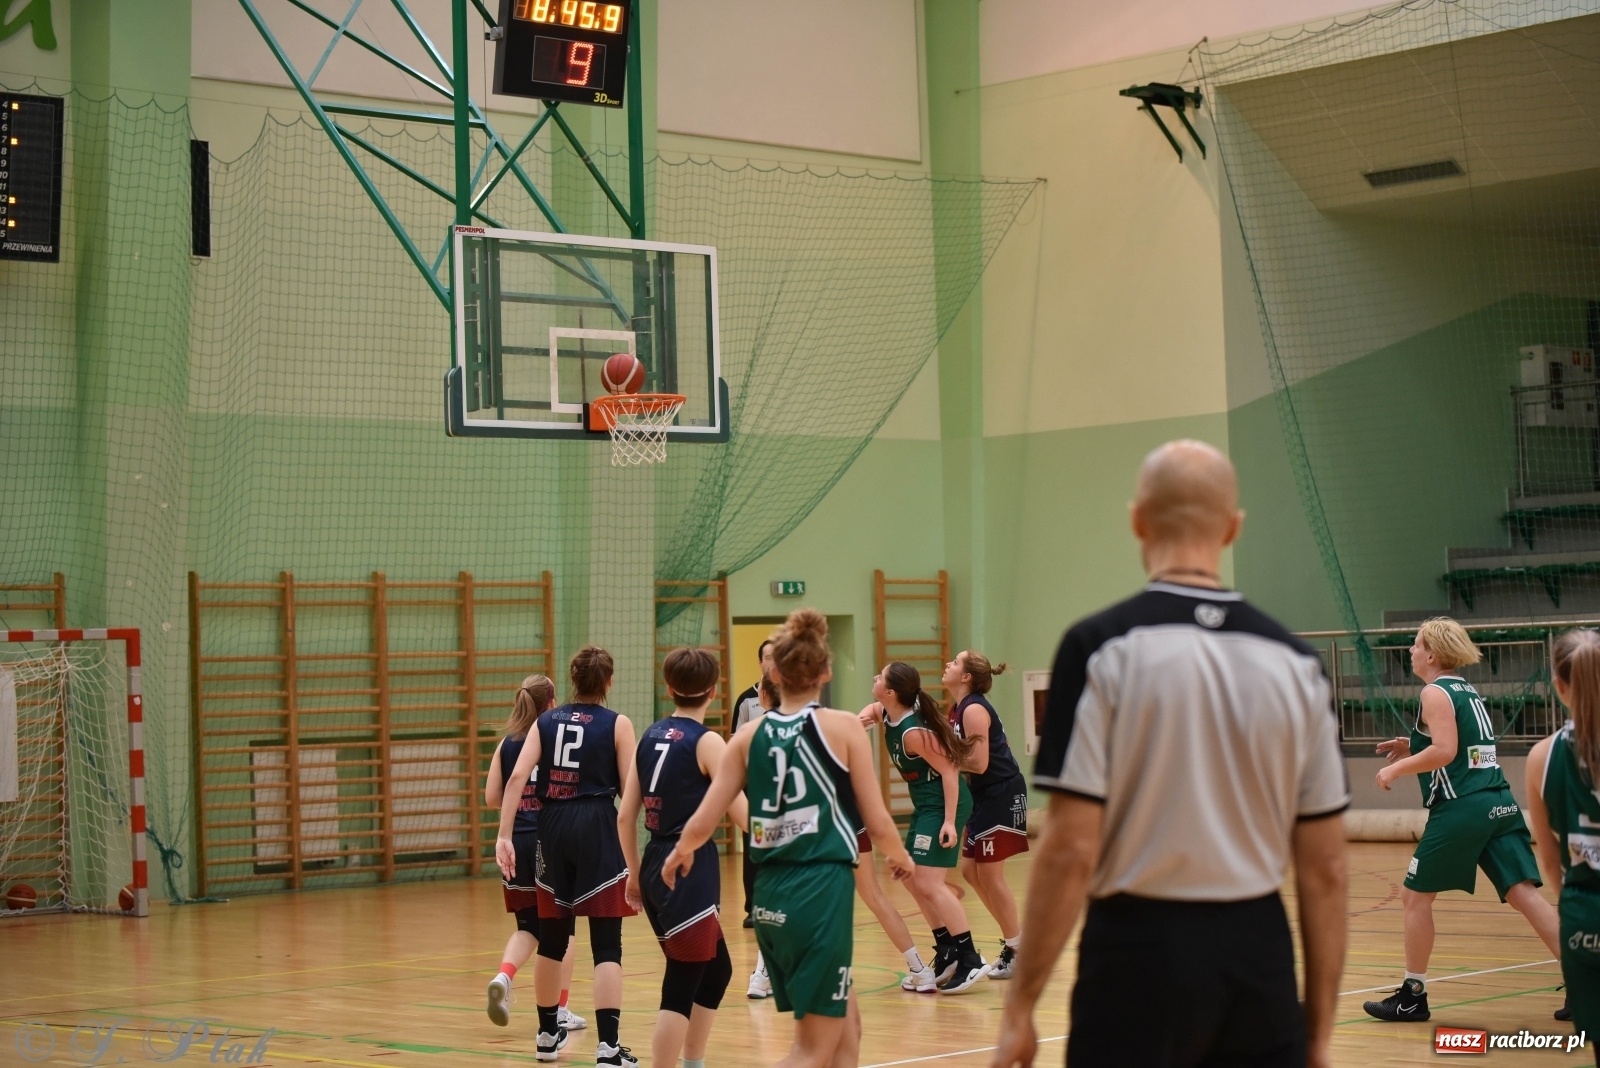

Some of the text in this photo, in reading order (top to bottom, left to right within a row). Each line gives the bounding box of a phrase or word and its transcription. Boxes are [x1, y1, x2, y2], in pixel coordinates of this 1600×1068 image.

[567, 42, 594, 85] 9
[593, 92, 608, 104] 3D
[455, 226, 485, 234] PESMENPOL
[2, 242, 53, 253] PRZEWINIENIA
[1469, 697, 1495, 740] 10
[554, 723, 584, 768] 12
[649, 743, 671, 793] 7
[1496, 803, 1518, 816] Clavis
[982, 840, 995, 857] 14
[756, 907, 787, 924] Clavis
